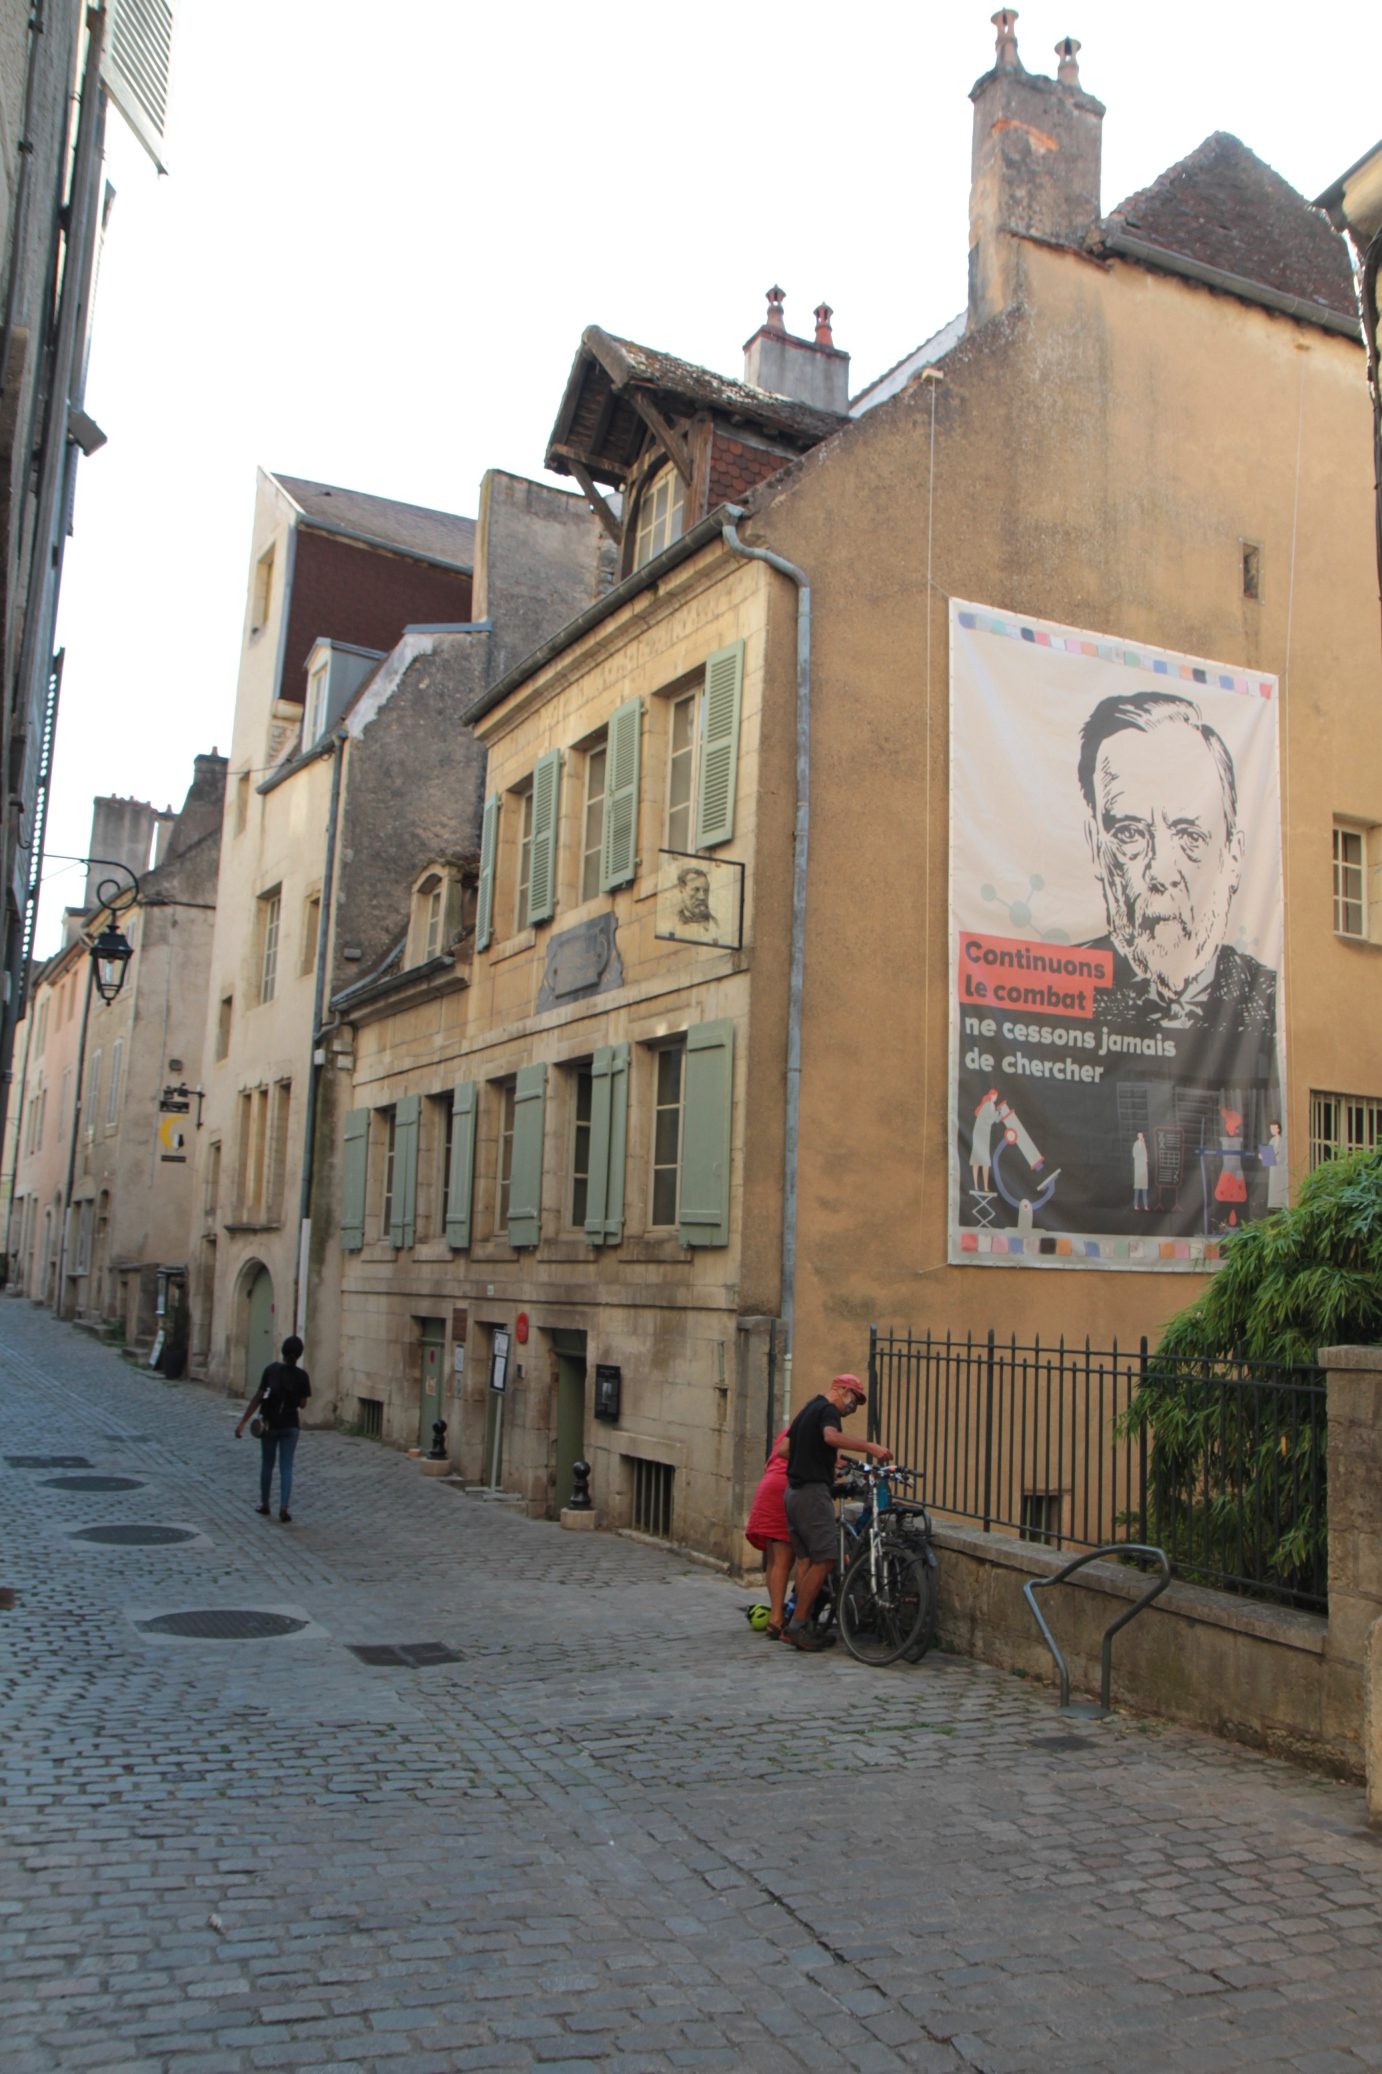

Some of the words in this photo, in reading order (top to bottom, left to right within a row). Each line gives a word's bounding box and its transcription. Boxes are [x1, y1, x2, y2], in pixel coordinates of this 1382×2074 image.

[965, 941, 1106, 979] Continuons
[965, 975, 987, 997] le
[993, 985, 1086, 1010] combat
[965, 1016, 996, 1037] ne
[1003, 1021, 1095, 1049] cessons
[1099, 1027, 1176, 1057] jamais
[965, 1047, 994, 1071] de
[1002, 1052, 1104, 1082] chercher
